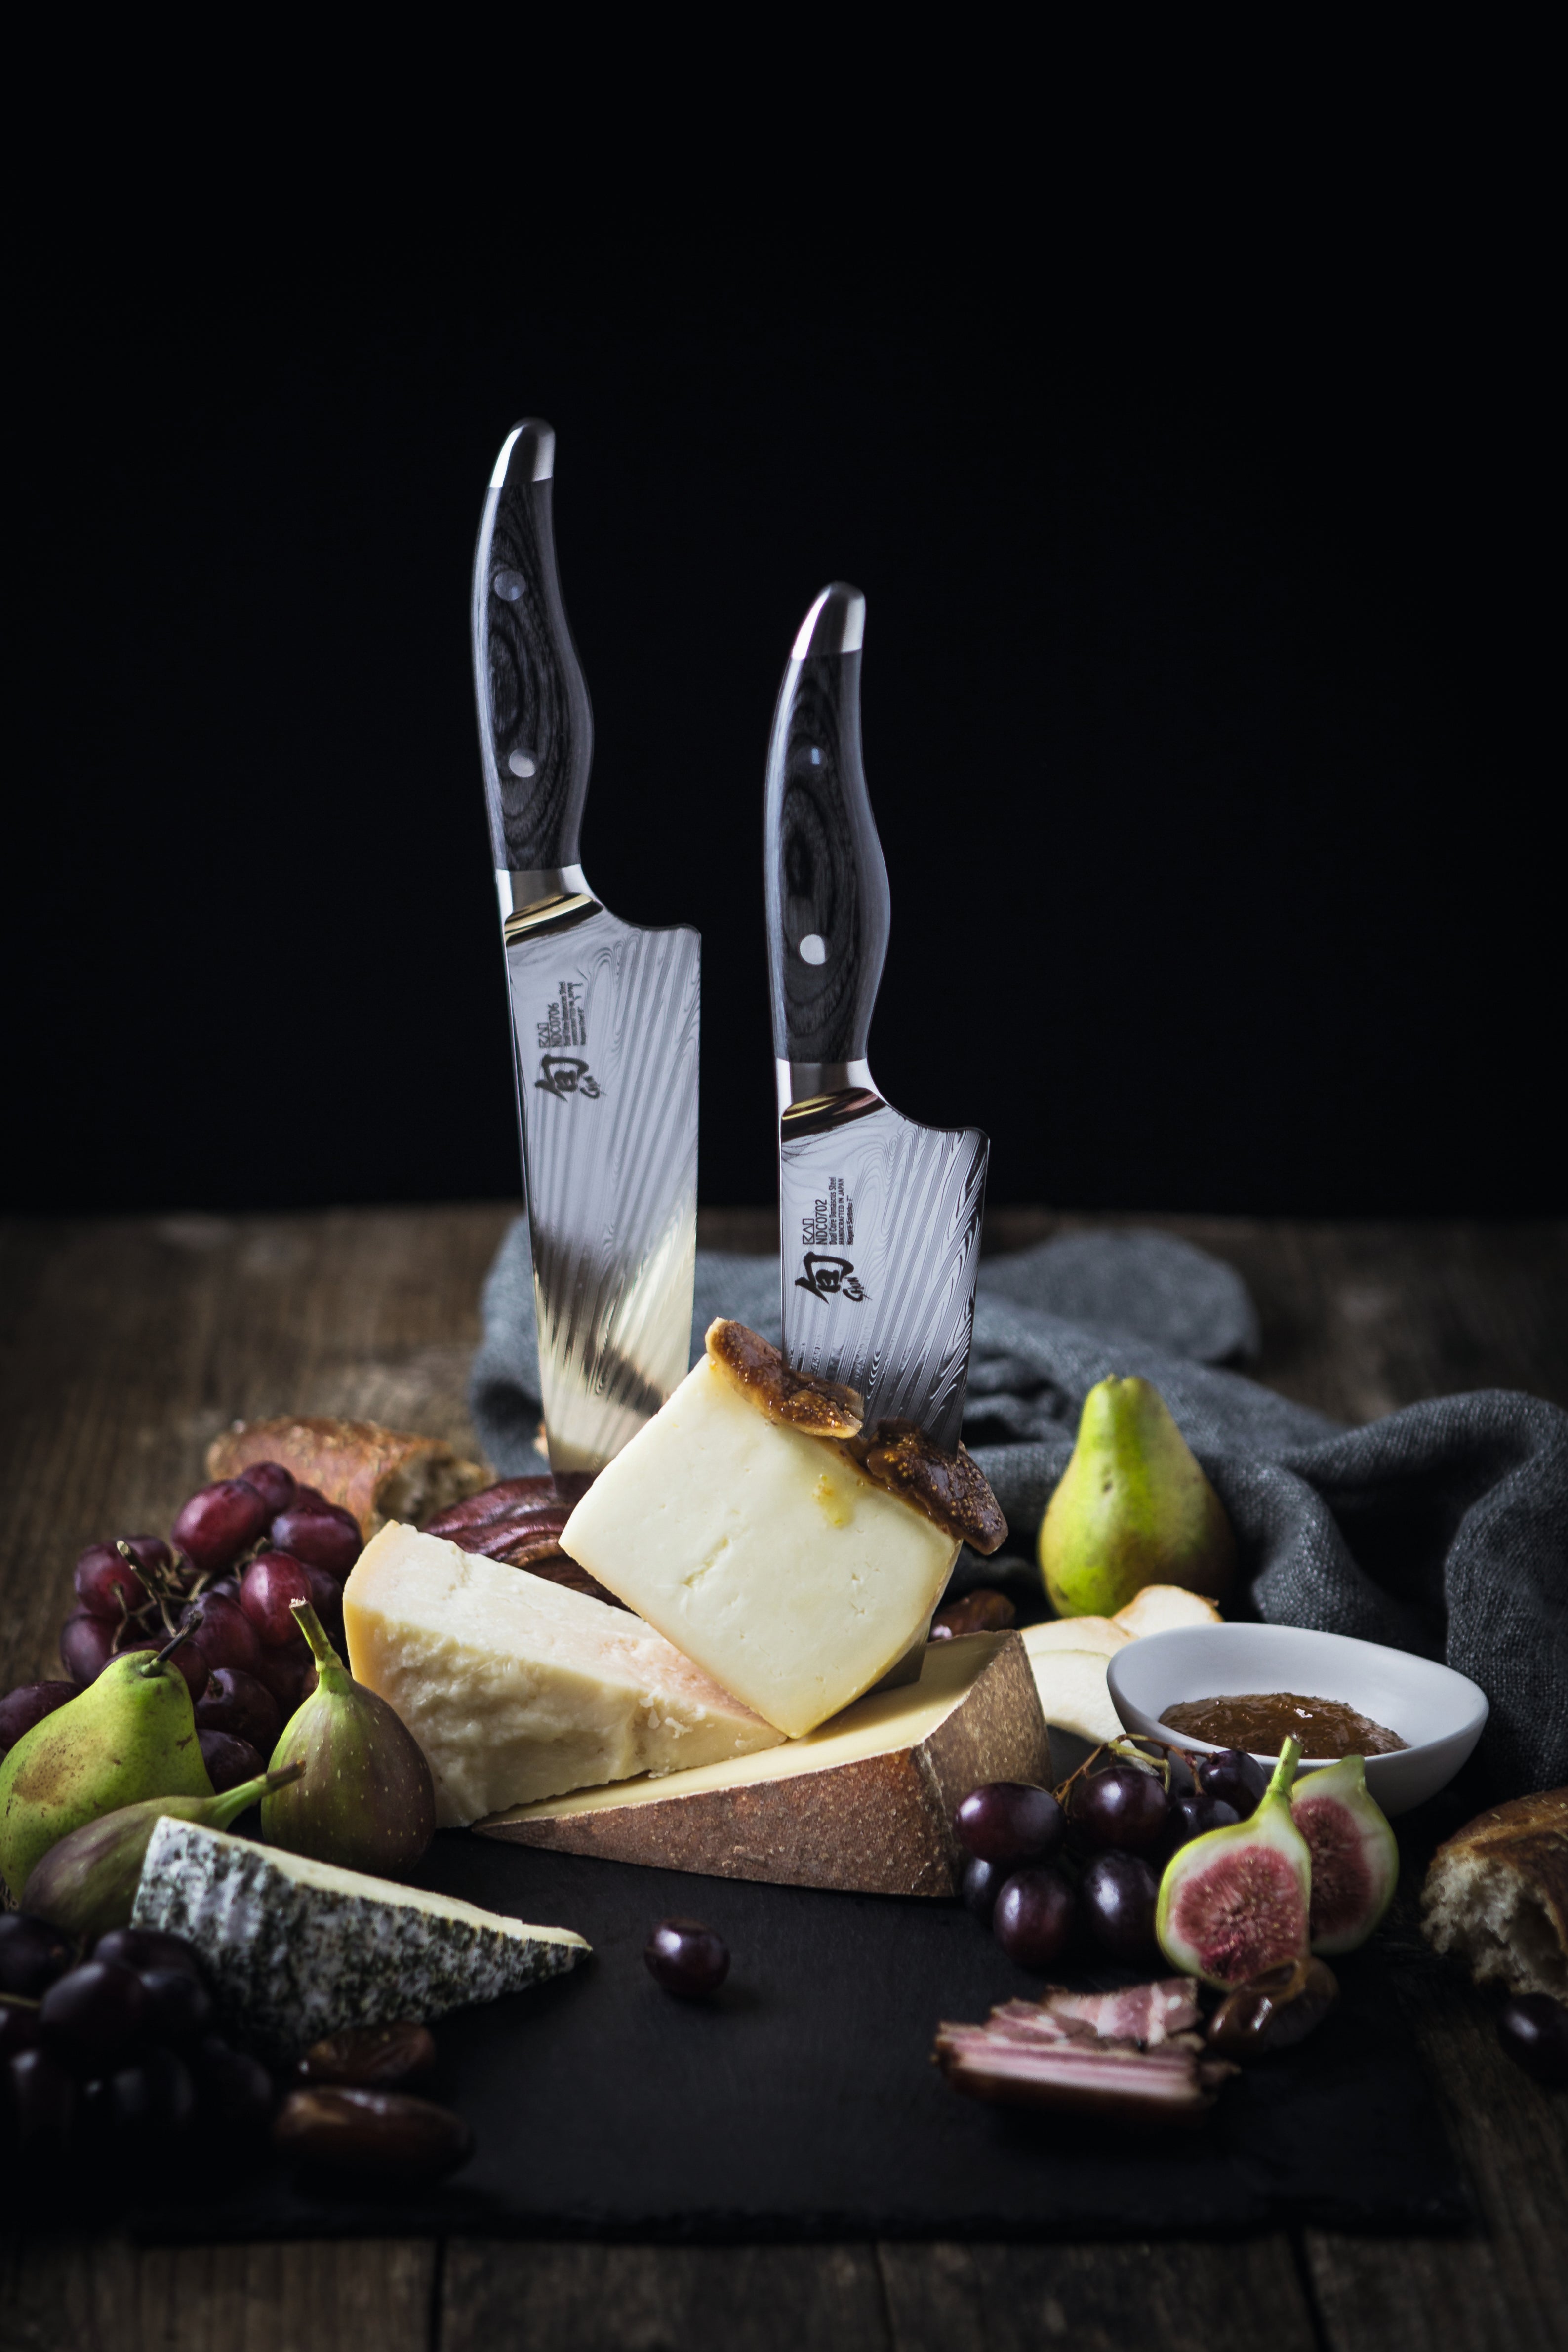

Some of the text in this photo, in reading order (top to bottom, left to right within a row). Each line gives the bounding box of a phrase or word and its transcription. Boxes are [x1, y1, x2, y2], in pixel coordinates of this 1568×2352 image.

[803, 1218, 814, 1245] KAI
[815, 1199, 827, 1245] NDC0702
[794, 1251, 854, 1304] 旬
